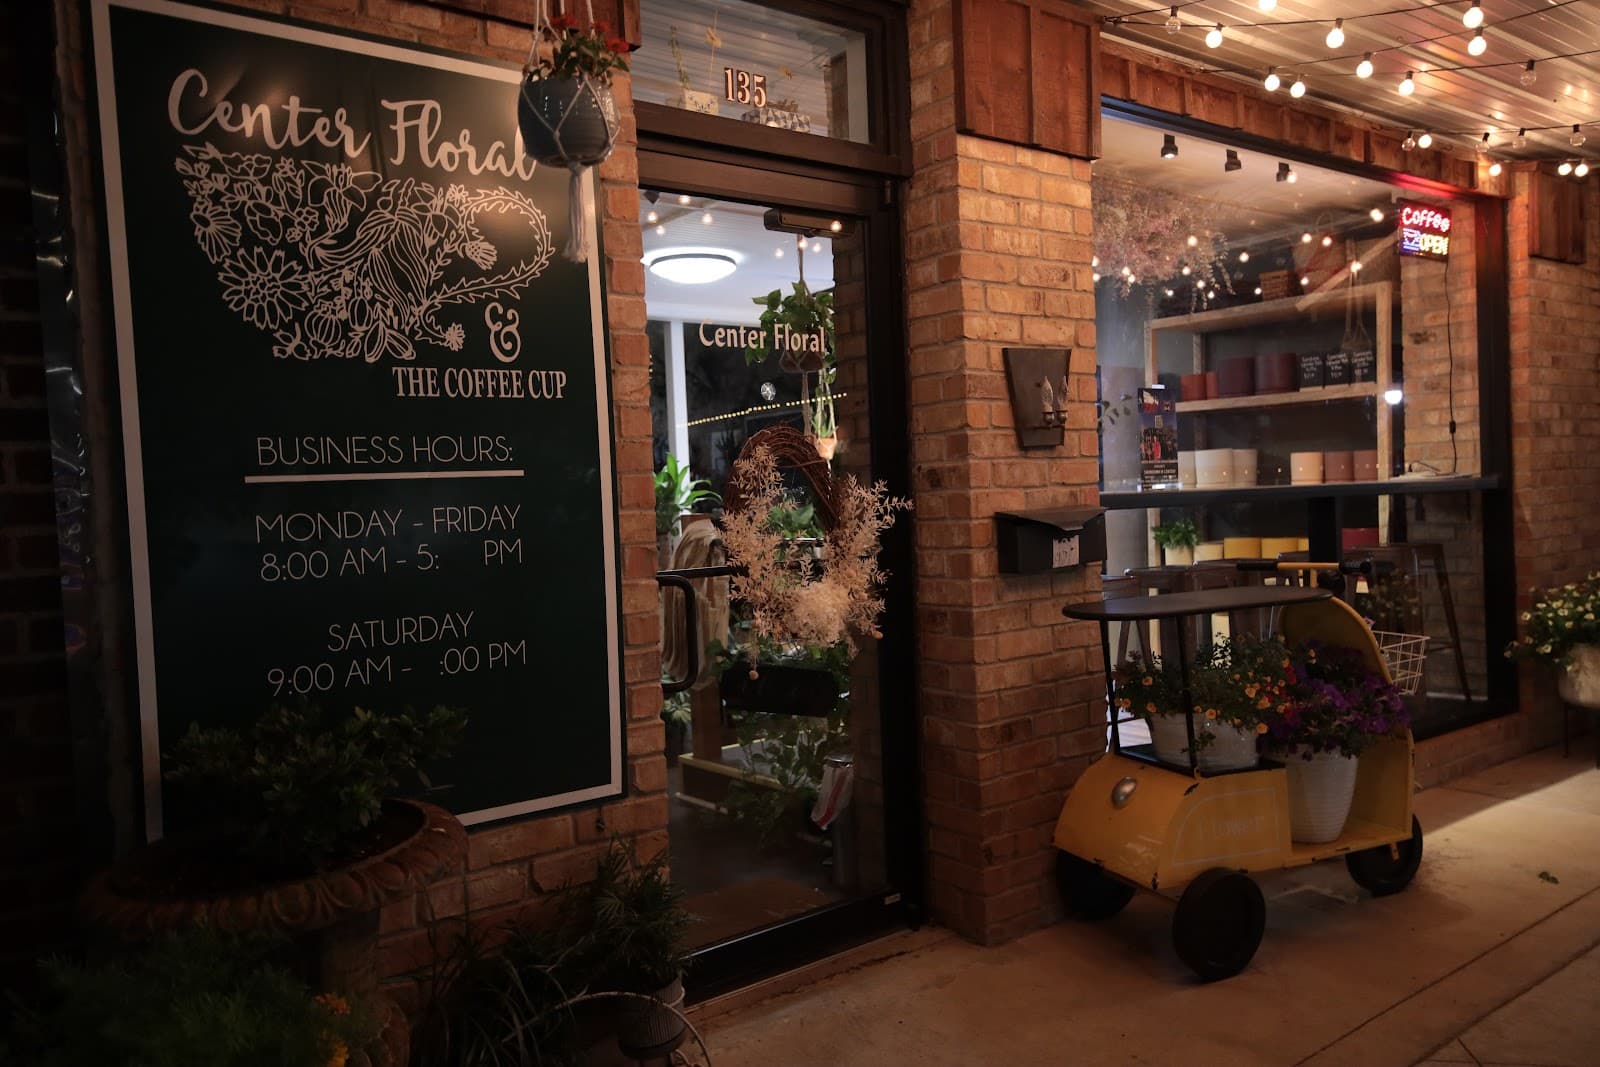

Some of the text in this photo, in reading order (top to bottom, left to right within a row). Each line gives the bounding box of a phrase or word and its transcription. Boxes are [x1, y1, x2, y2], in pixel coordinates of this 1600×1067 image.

[725, 69, 767, 108] 135
[168, 69, 537, 181] Center Floral
[1401, 207, 1450, 232] Coffee
[1419, 233, 1449, 256] OPEN
[484, 302, 521, 362] &
[699, 319, 826, 352] Center Floral
[392, 366, 567, 399] THE COFFEE CUP
[256, 435, 513, 466] BUSINESS HOURS:
[255, 509, 402, 544] MONDAY
[433, 504, 521, 534] FRIDAY
[260, 550, 329, 582] 8:00
[339, 546, 387, 577] AM
[484, 538, 522, 566] PM
[327, 610, 475, 652] SATURDAY
[267, 662, 335, 697] 9:00
[344, 655, 392, 688] AM
[488, 639, 526, 669] PM
